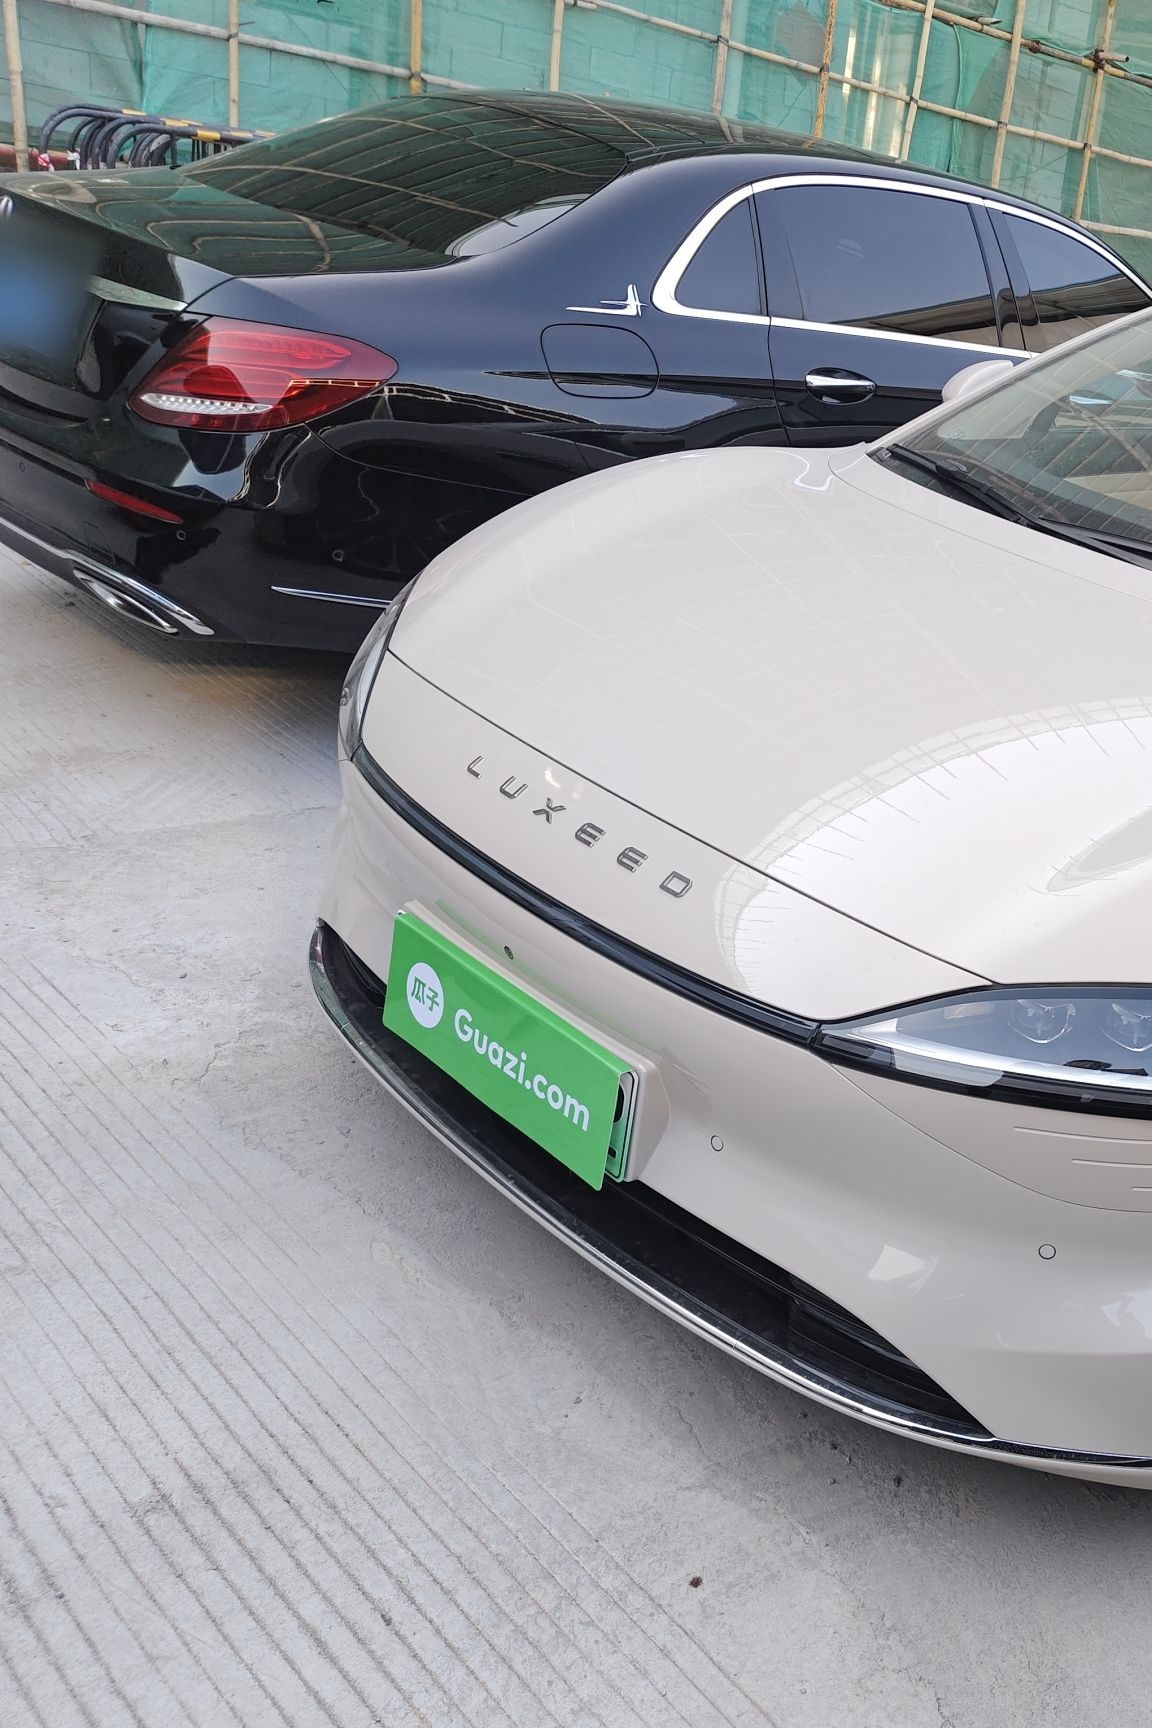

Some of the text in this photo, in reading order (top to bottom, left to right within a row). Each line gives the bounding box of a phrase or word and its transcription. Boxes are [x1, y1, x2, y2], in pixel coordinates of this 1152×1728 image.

[466, 755, 693, 898] LUXEED
[411, 976, 440, 1012] 瓜子
[454, 1008, 590, 1131] Guazi.com
